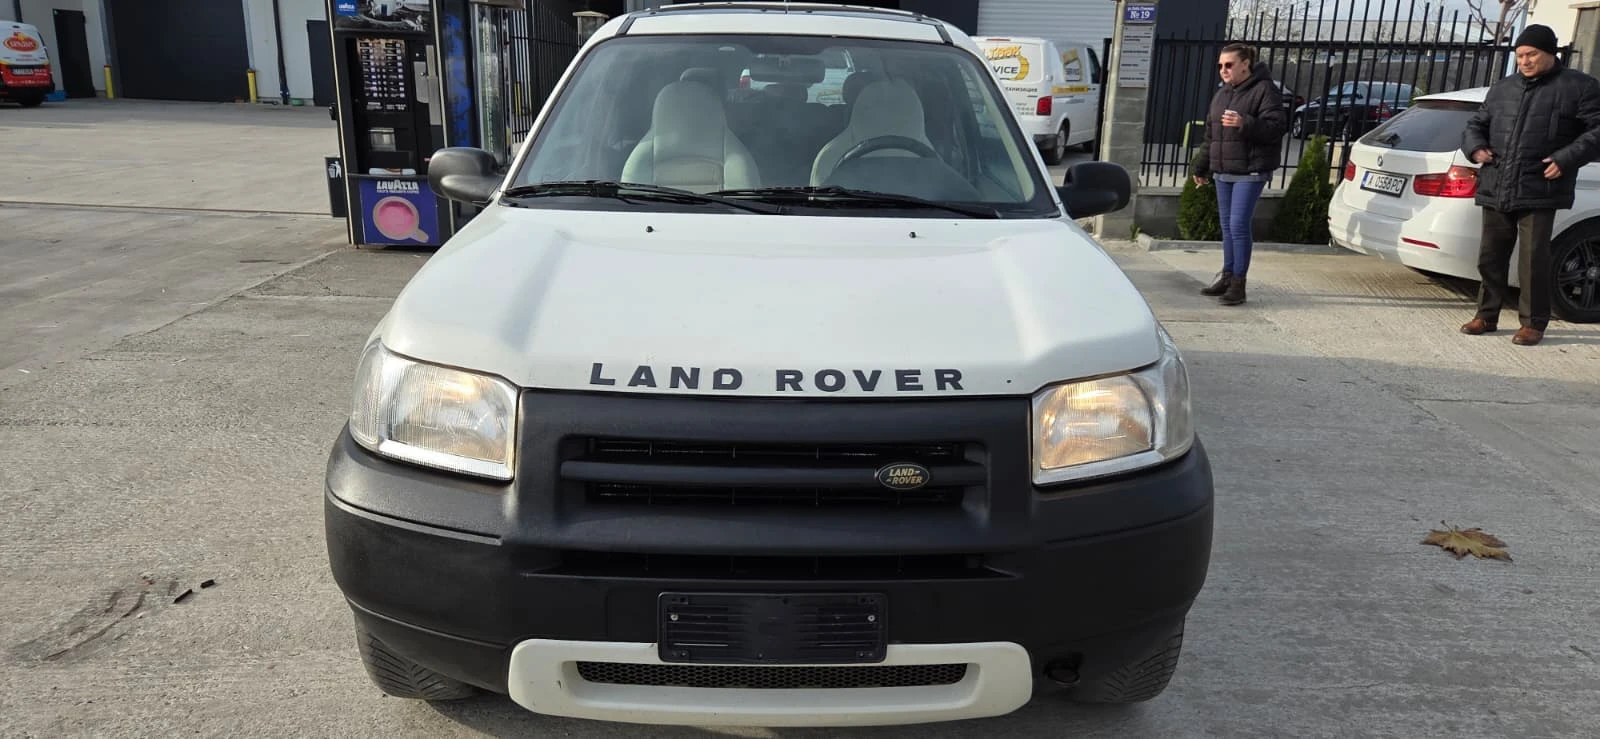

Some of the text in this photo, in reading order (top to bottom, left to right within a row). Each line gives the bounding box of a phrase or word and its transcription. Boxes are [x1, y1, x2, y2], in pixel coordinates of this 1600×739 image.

[1141, 10, 1150, 19] 19
[376, 179, 420, 190] LAVAZZA
[590, 362, 964, 392] LAND ROVER
